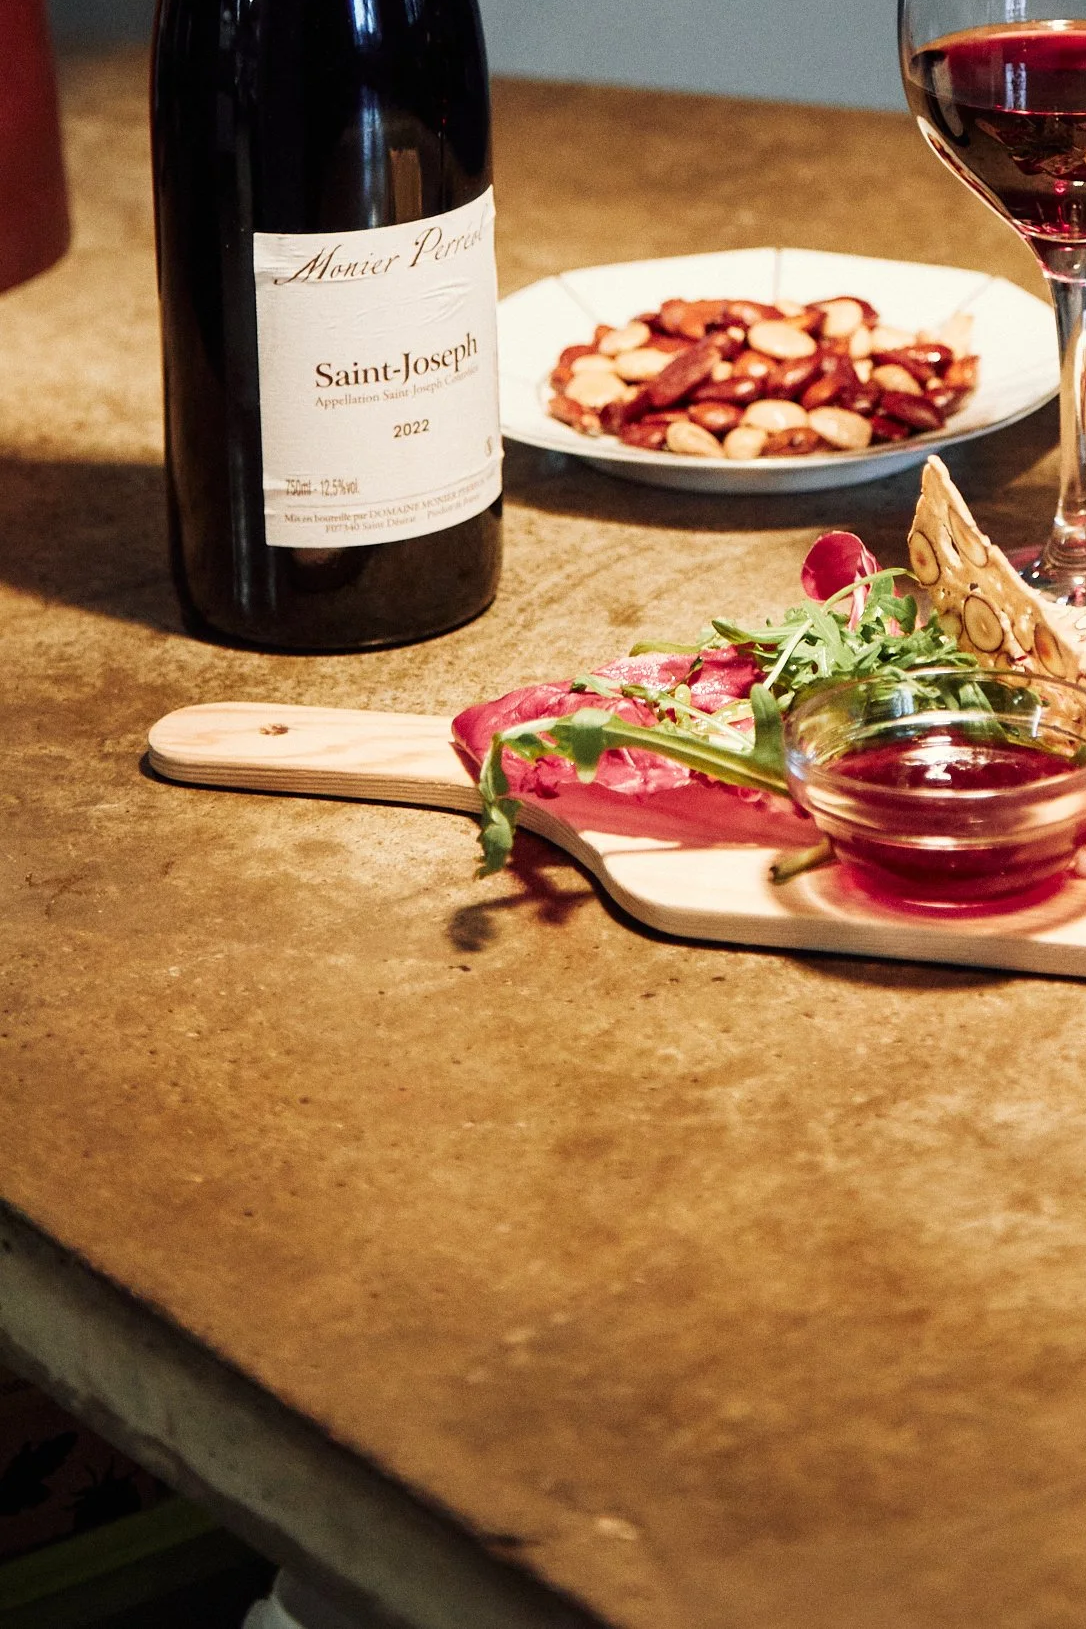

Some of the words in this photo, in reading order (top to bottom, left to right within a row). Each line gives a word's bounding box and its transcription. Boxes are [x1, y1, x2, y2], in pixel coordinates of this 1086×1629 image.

[274, 243, 400, 285] Monier
[315, 332, 477, 388] Saint-Joseph
[315, 394, 380, 409] Appellation
[393, 419, 430, 438] 2022
